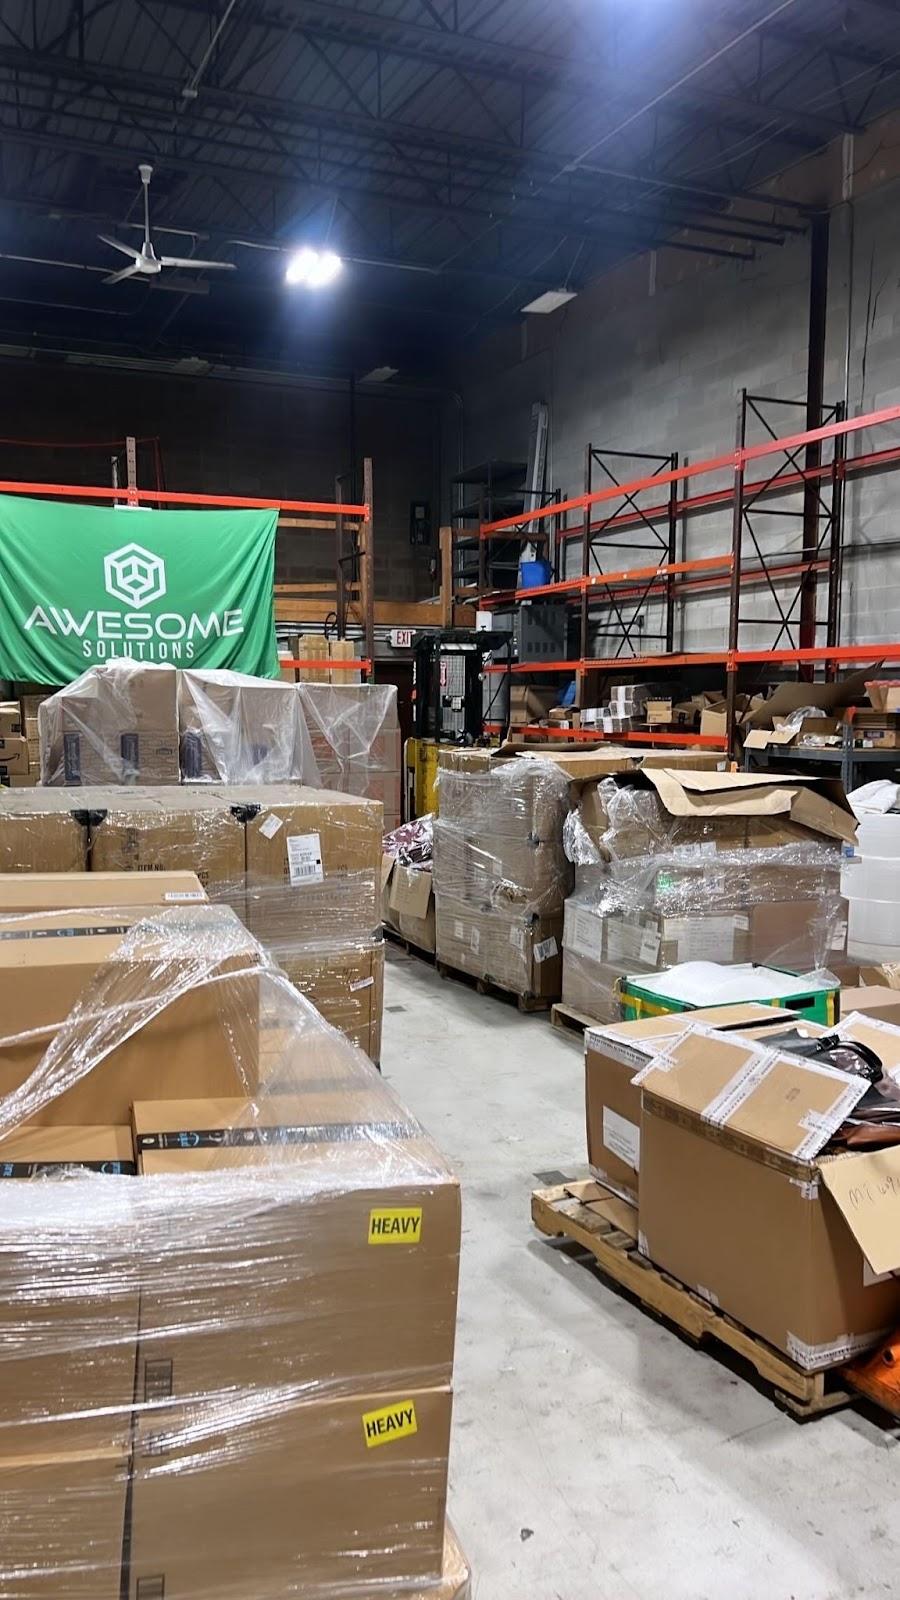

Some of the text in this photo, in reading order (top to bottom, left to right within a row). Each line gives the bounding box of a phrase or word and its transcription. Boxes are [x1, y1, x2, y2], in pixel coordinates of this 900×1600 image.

[24, 605, 244, 640] AWESOME
[82, 640, 194, 659] SOLUTIONS
[371, 1216, 420, 1234] HEAVY
[366, 1408, 413, 1437] HEAVY
